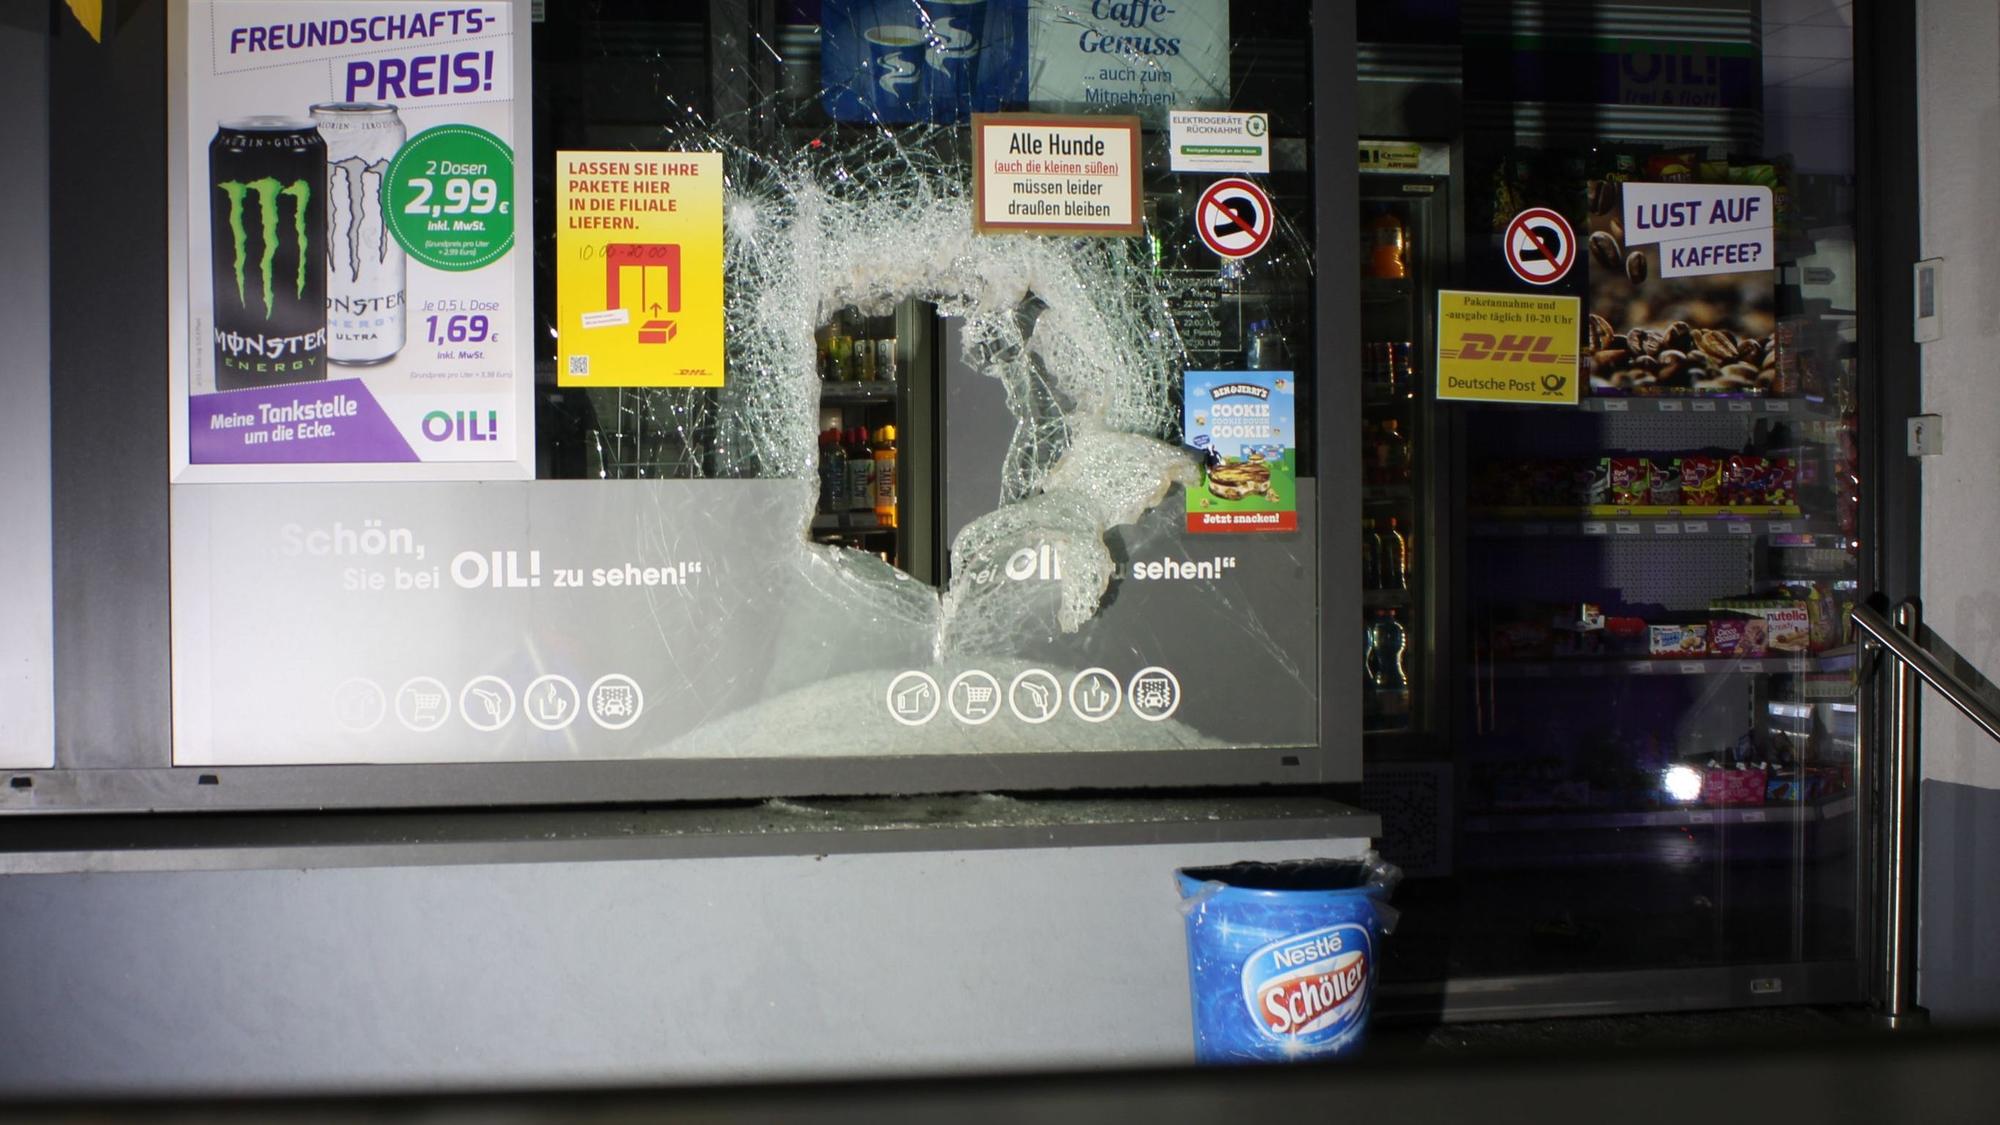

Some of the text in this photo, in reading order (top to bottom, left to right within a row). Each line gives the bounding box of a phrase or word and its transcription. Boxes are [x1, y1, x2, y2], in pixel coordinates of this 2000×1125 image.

[230, 8, 495, 53] FREUNDSCHAFTS-
[1079, 29, 1180, 56] Genuss
[346, 50, 494, 102] PREIS!
[1099, 68, 1135, 80] auch
[1140, 71, 1172, 81] zum
[1173, 115, 1242, 124] ELEKTROGERÄTE
[1187, 125, 1242, 134] RÜCKNAHME
[1009, 133, 1104, 156] Alle Hunde
[426, 160, 487, 175] 2 Dosen
[570, 162, 699, 176] LASSEN SIE IHRE
[994, 159, 1119, 176] (auch die kleinen süßen)
[570, 180, 670, 194] PAKETE HIER
[1013, 180, 1102, 195] müssen leider
[404, 178, 509, 216] 2,99 €
[570, 198, 677, 212] IN DIE FILIALE
[1008, 200, 1110, 217] draußen bleiben
[1637, 197, 1760, 229] LUST AUF
[428, 220, 486, 231] inkl. MwSt.
[570, 216, 639, 229] LIEFERN.
[1671, 242, 1762, 269] KAFFEE?
[422, 300, 499, 313] Je 0,5 L Dose
[1464, 296, 1556, 310] Paketannahme und
[1490, 312, 1522, 323] täglich
[1554, 315, 1573, 324] Uhr
[335, 332, 379, 341] ULTRA
[426, 315, 499, 345] 1,69 €
[438, 351, 485, 359] inkl. MwSt.
[1458, 333, 1558, 363] DHL
[225, 357, 317, 372] ENERGY
[1448, 376, 1536, 391] Deutsche Post
[211, 395, 357, 429] Meine Tankstelle
[1211, 404, 1270, 417] COOKIE
[244, 422, 335, 444] um die Ecke.
[422, 410, 497, 442] OIL!
[1211, 425, 1270, 438] COOKIE
[1203, 512, 1280, 524] Jetzt snacken!
[280, 520, 425, 560] Schön,
[343, 566, 385, 591] Sie
[394, 565, 440, 590] bei
[450, 550, 541, 588] OIL!
[553, 568, 583, 587] zu
[1767, 610, 1807, 621] nutella
[1273, 931, 1342, 969] Nestlé
[1265, 958, 1364, 1033] Schöller
